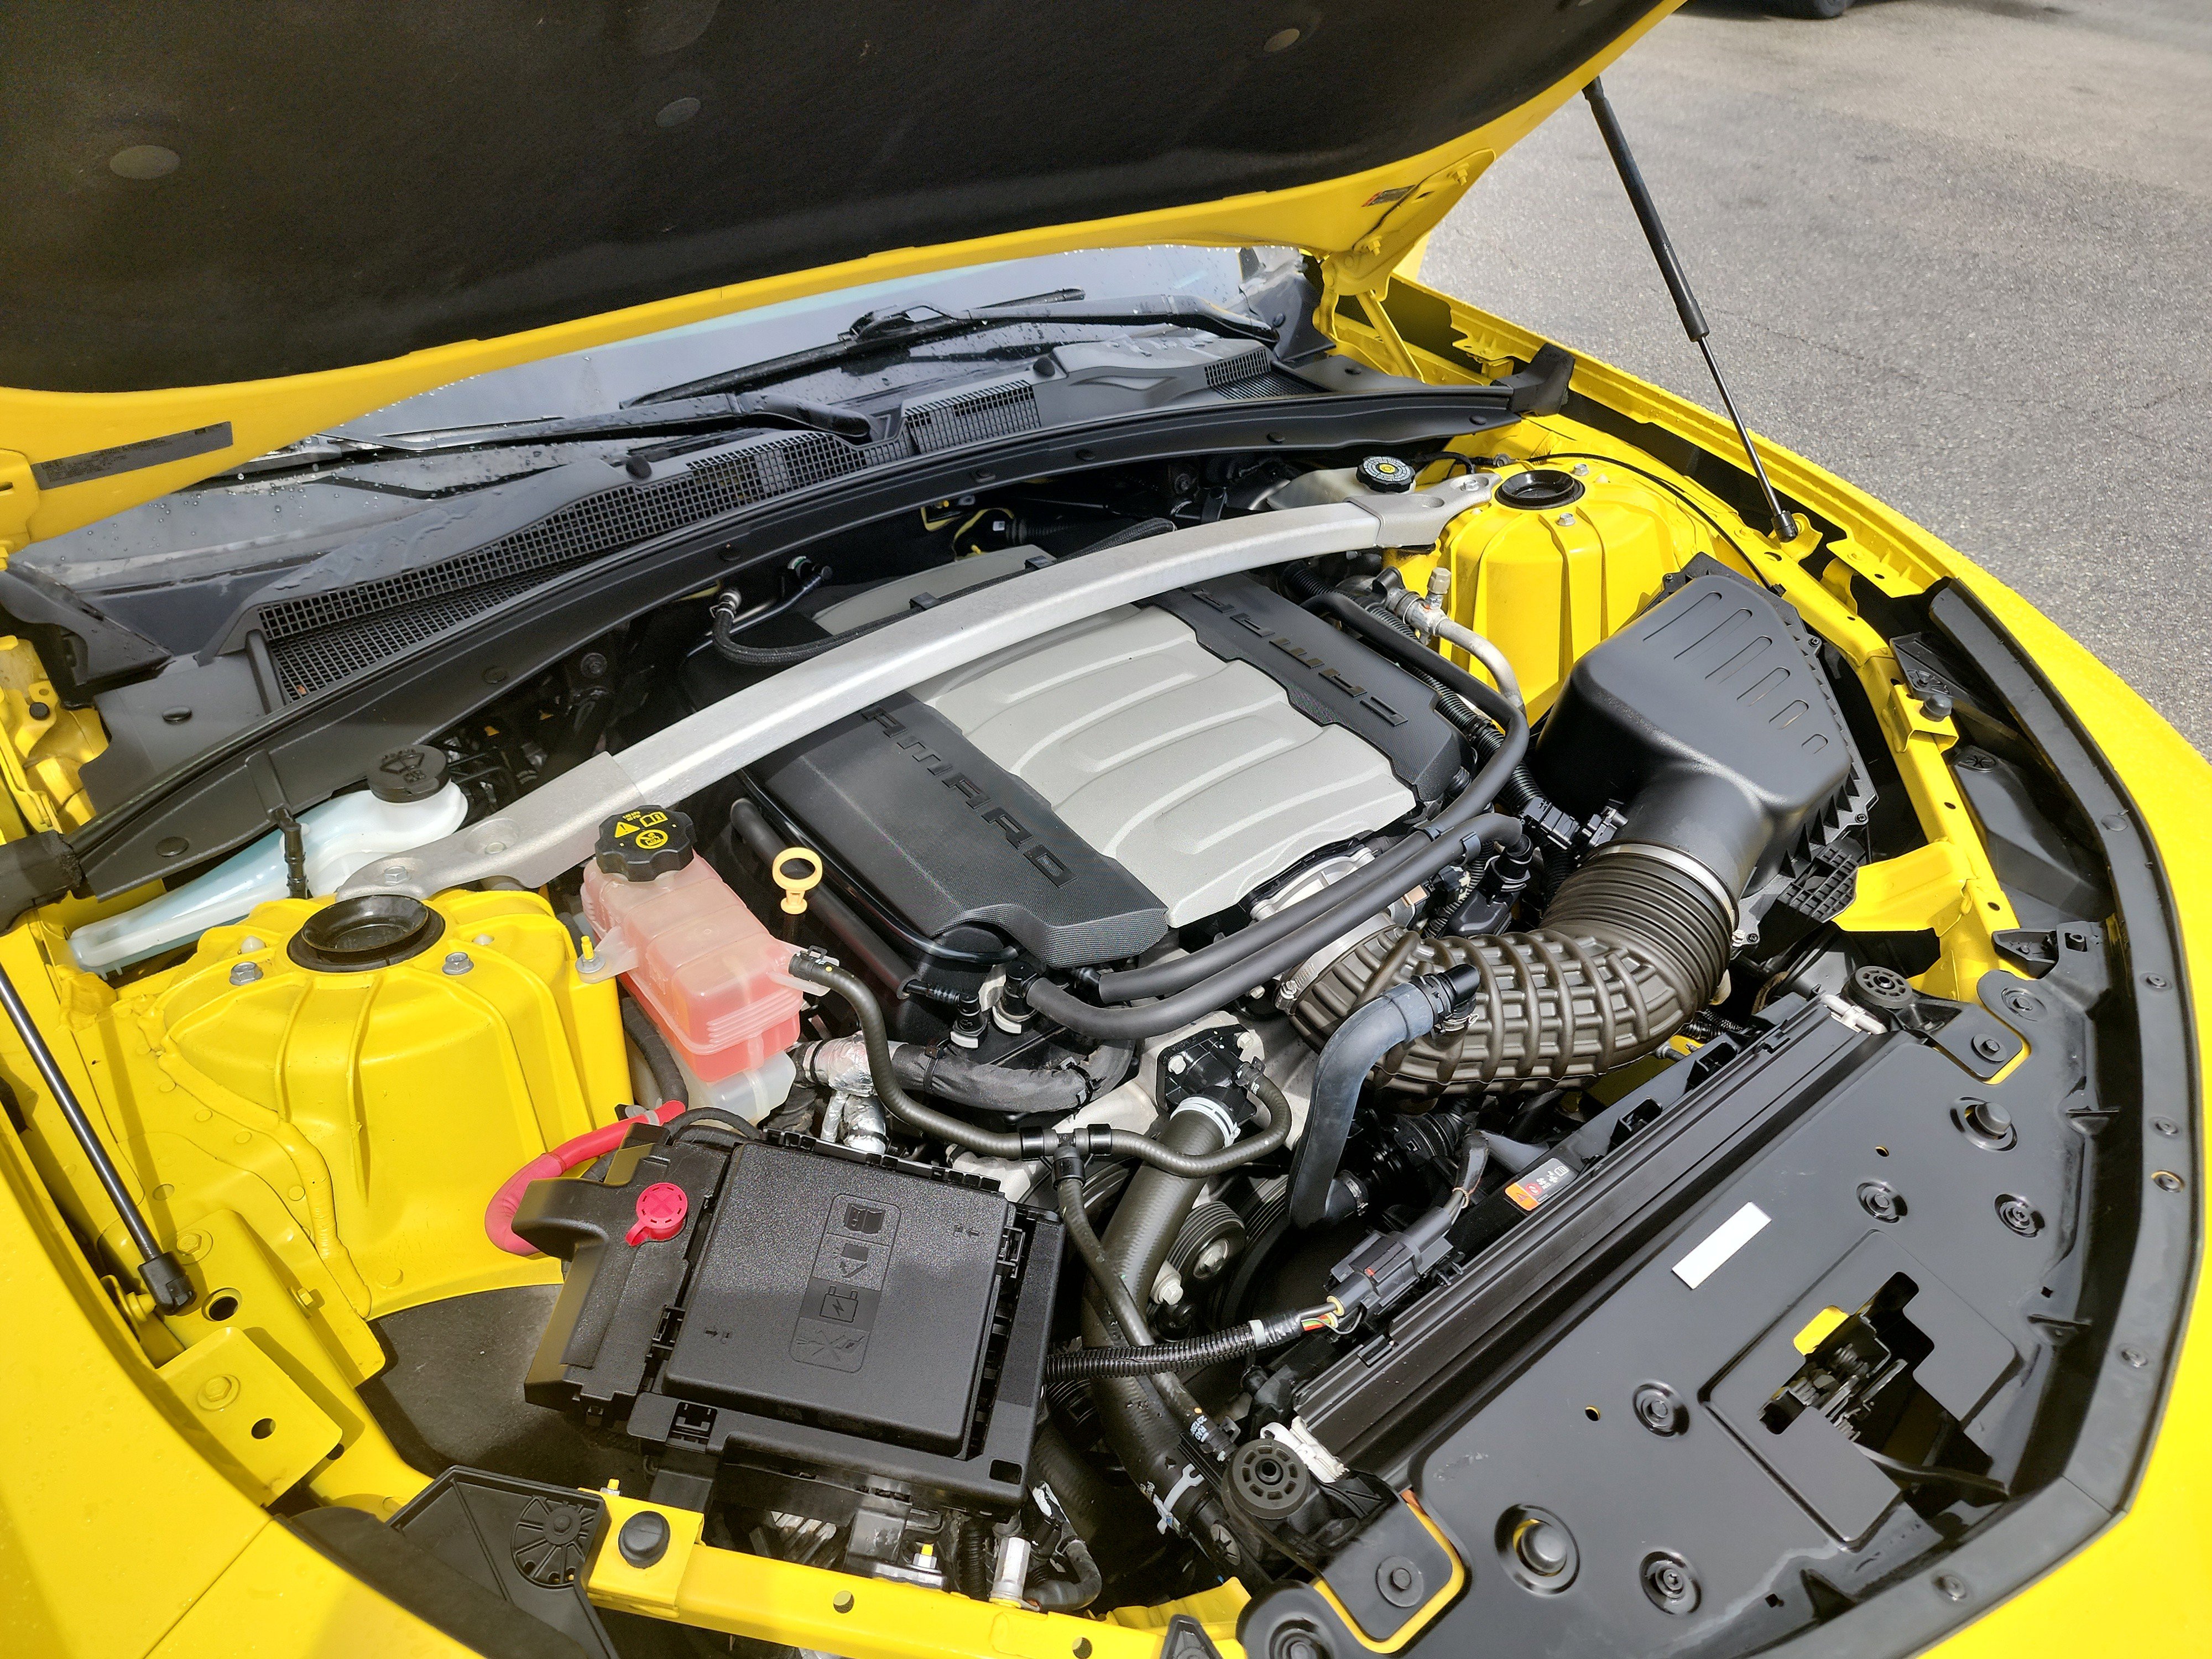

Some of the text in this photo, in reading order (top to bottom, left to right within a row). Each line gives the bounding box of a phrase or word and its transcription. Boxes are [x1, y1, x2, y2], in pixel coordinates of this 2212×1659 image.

[1189, 587, 1408, 726] CAMAR
[861, 706, 1078, 888] AMARO
[1194, 1425, 1207, 1441] RAD
